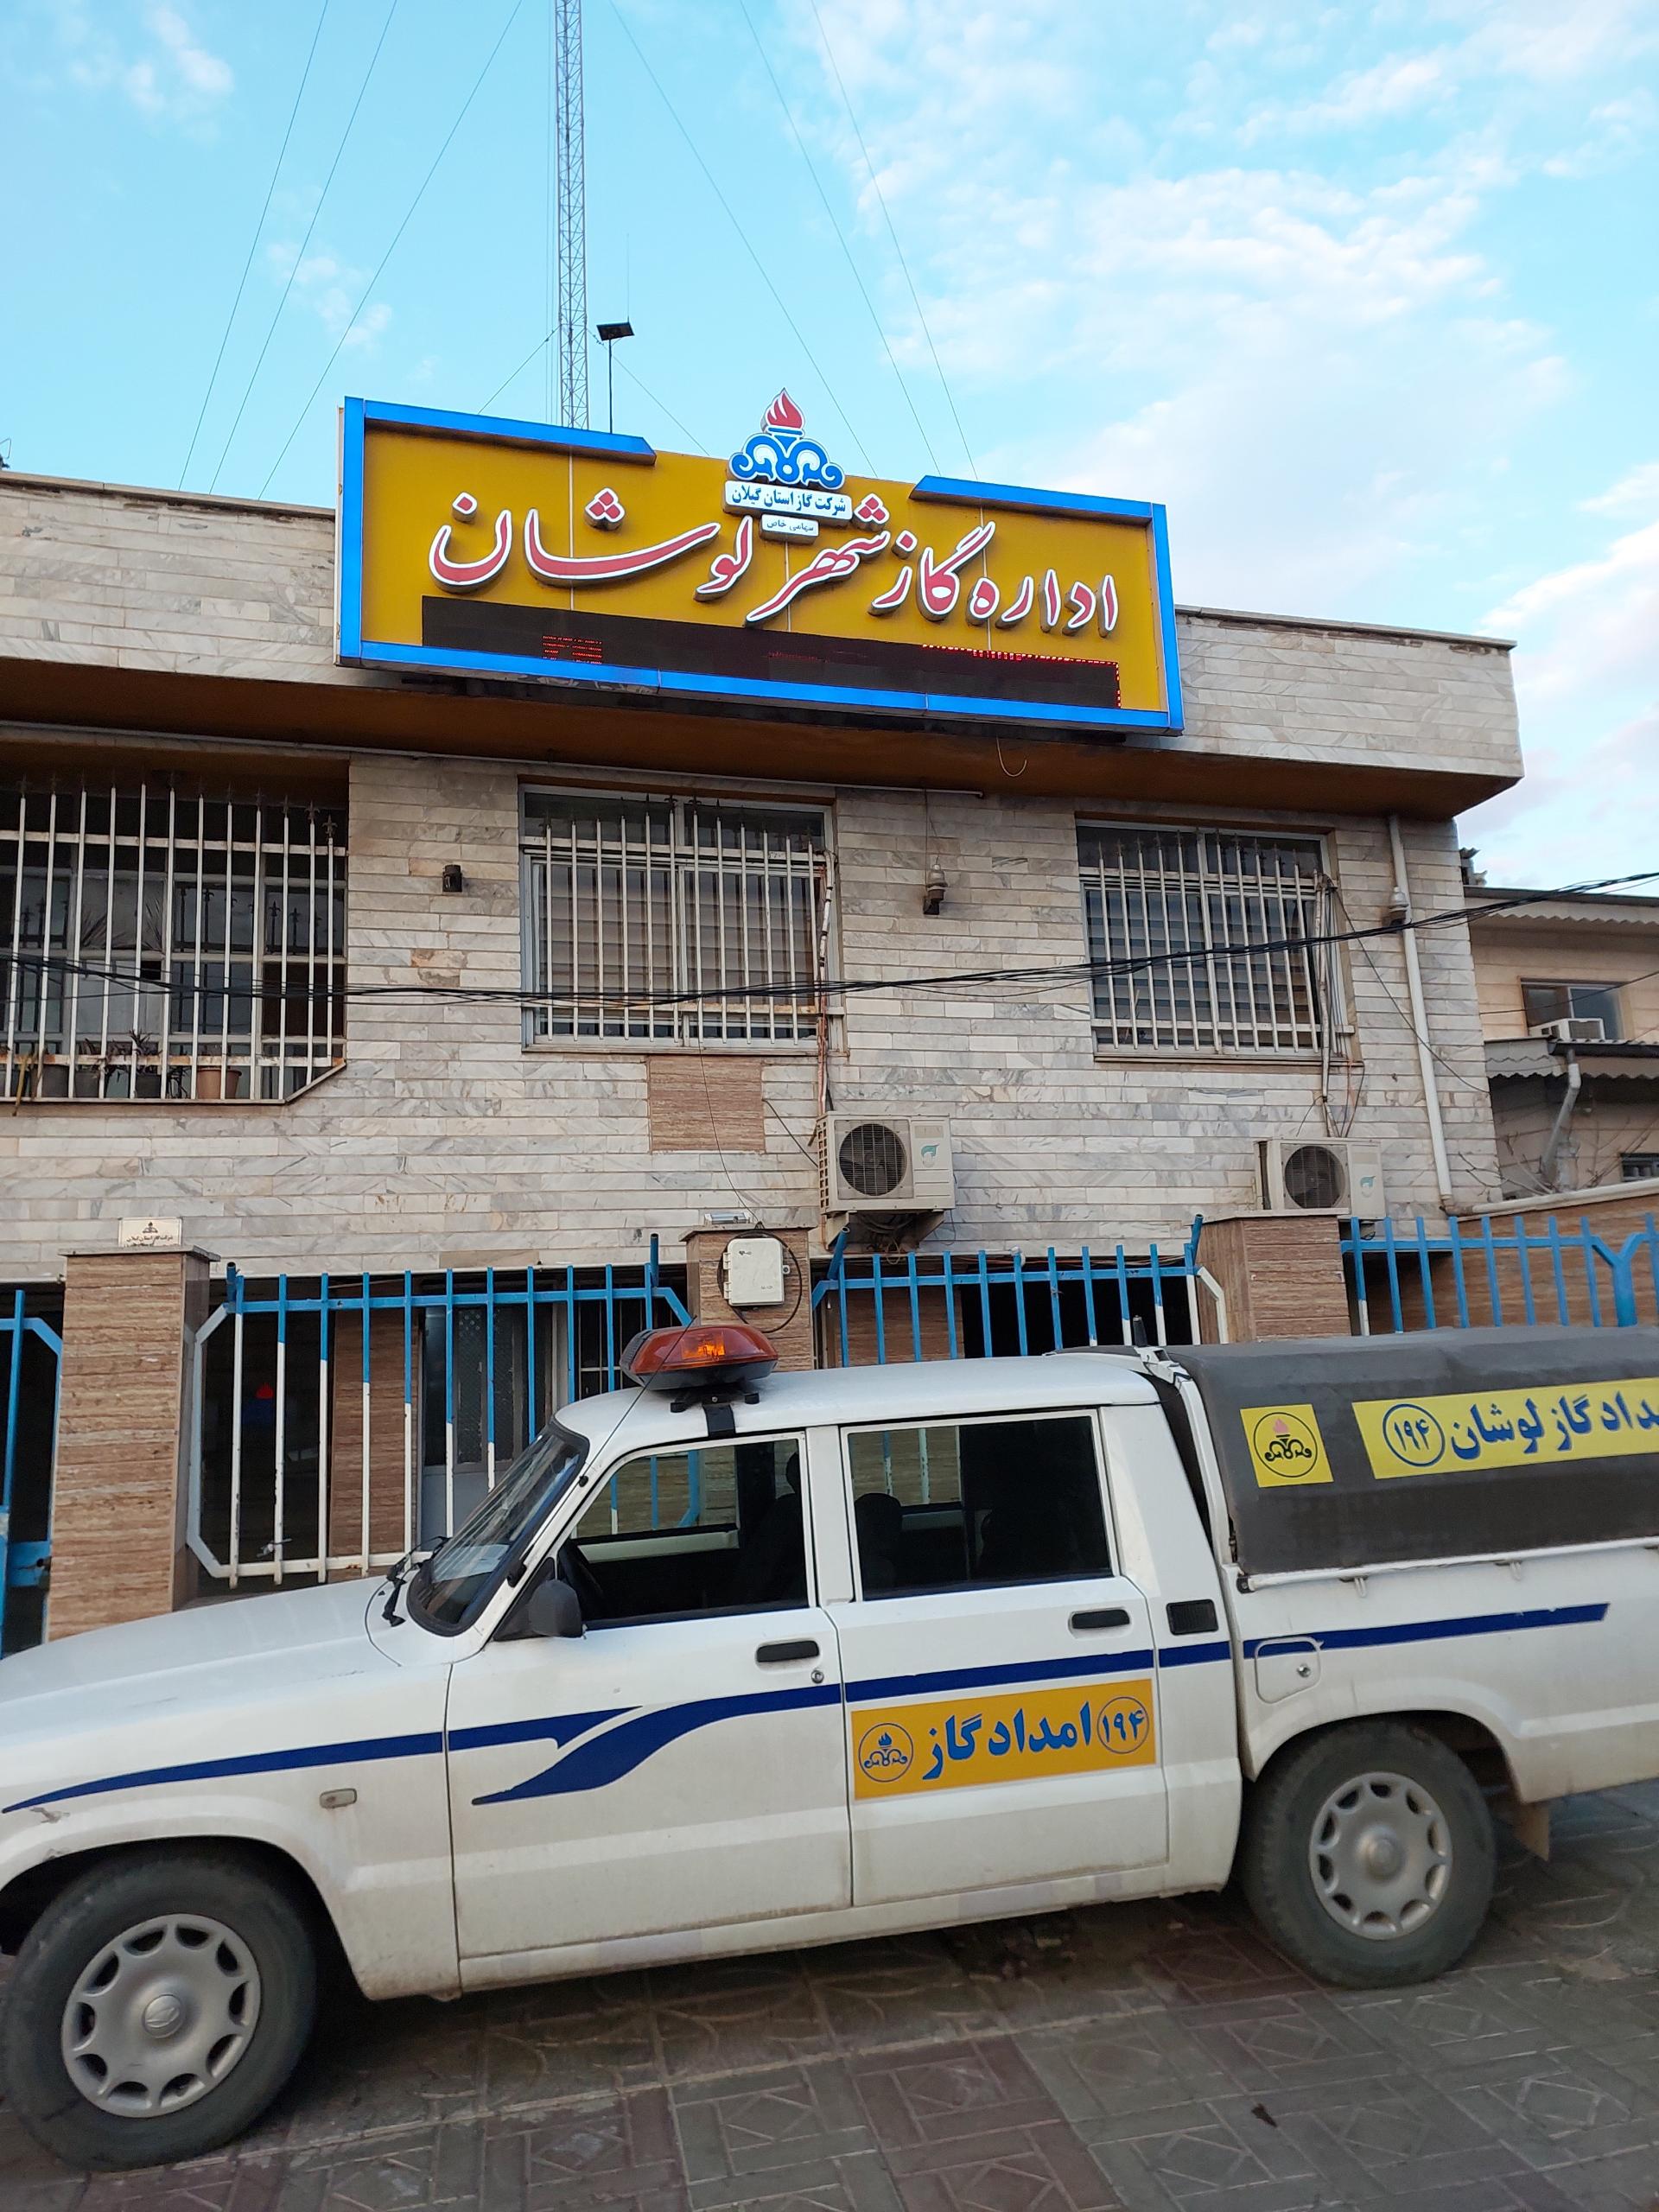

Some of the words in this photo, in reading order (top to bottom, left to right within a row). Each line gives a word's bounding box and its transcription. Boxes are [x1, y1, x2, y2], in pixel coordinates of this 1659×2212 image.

[732, 485, 761, 504] گیلان
[764, 488, 793, 506] استان
[796, 493, 812, 511] گاز
[815, 498, 846, 516] شرکت
[428, 487, 753, 600] لوشان
[766, 518, 786, 528] خاص
[790, 523, 814, 531] سهامی
[746, 493, 890, 625] شهر
[872, 520, 995, 619] گاز
[967, 568, 1117, 638] اداره
[1394, 1420, 1430, 1451] ۱۹۴
[1452, 1398, 1545, 1460] لوشان
[1551, 1394, 1592, 1451] گاز
[923, 1713, 982, 1780] گاز
[988, 1700, 1091, 1756] امداد
[1103, 1709, 1146, 1744] ۱۹۴
